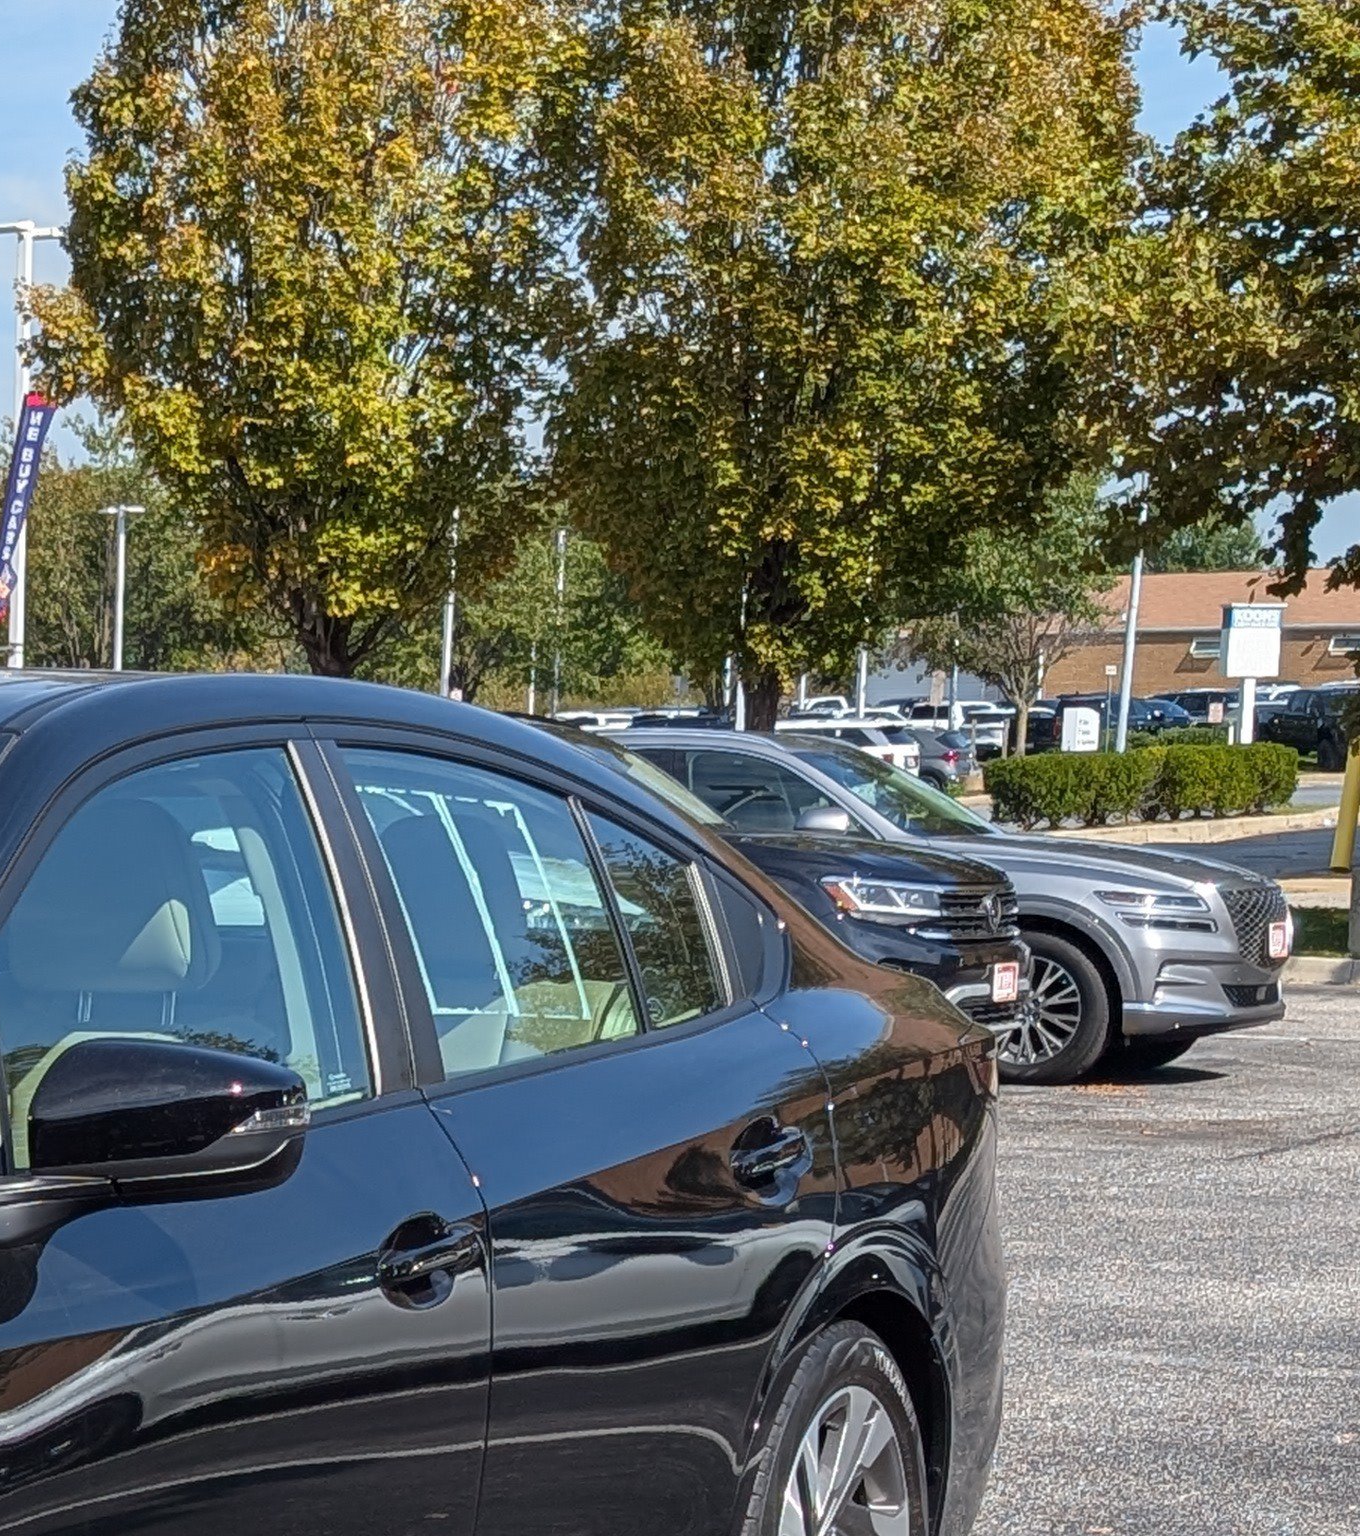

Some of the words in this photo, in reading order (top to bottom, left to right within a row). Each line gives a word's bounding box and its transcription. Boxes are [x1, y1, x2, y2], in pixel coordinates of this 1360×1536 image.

[27, 410, 44, 441] WE
[16, 447, 35, 494] BUY
[0, 500, 24, 561] CARS
